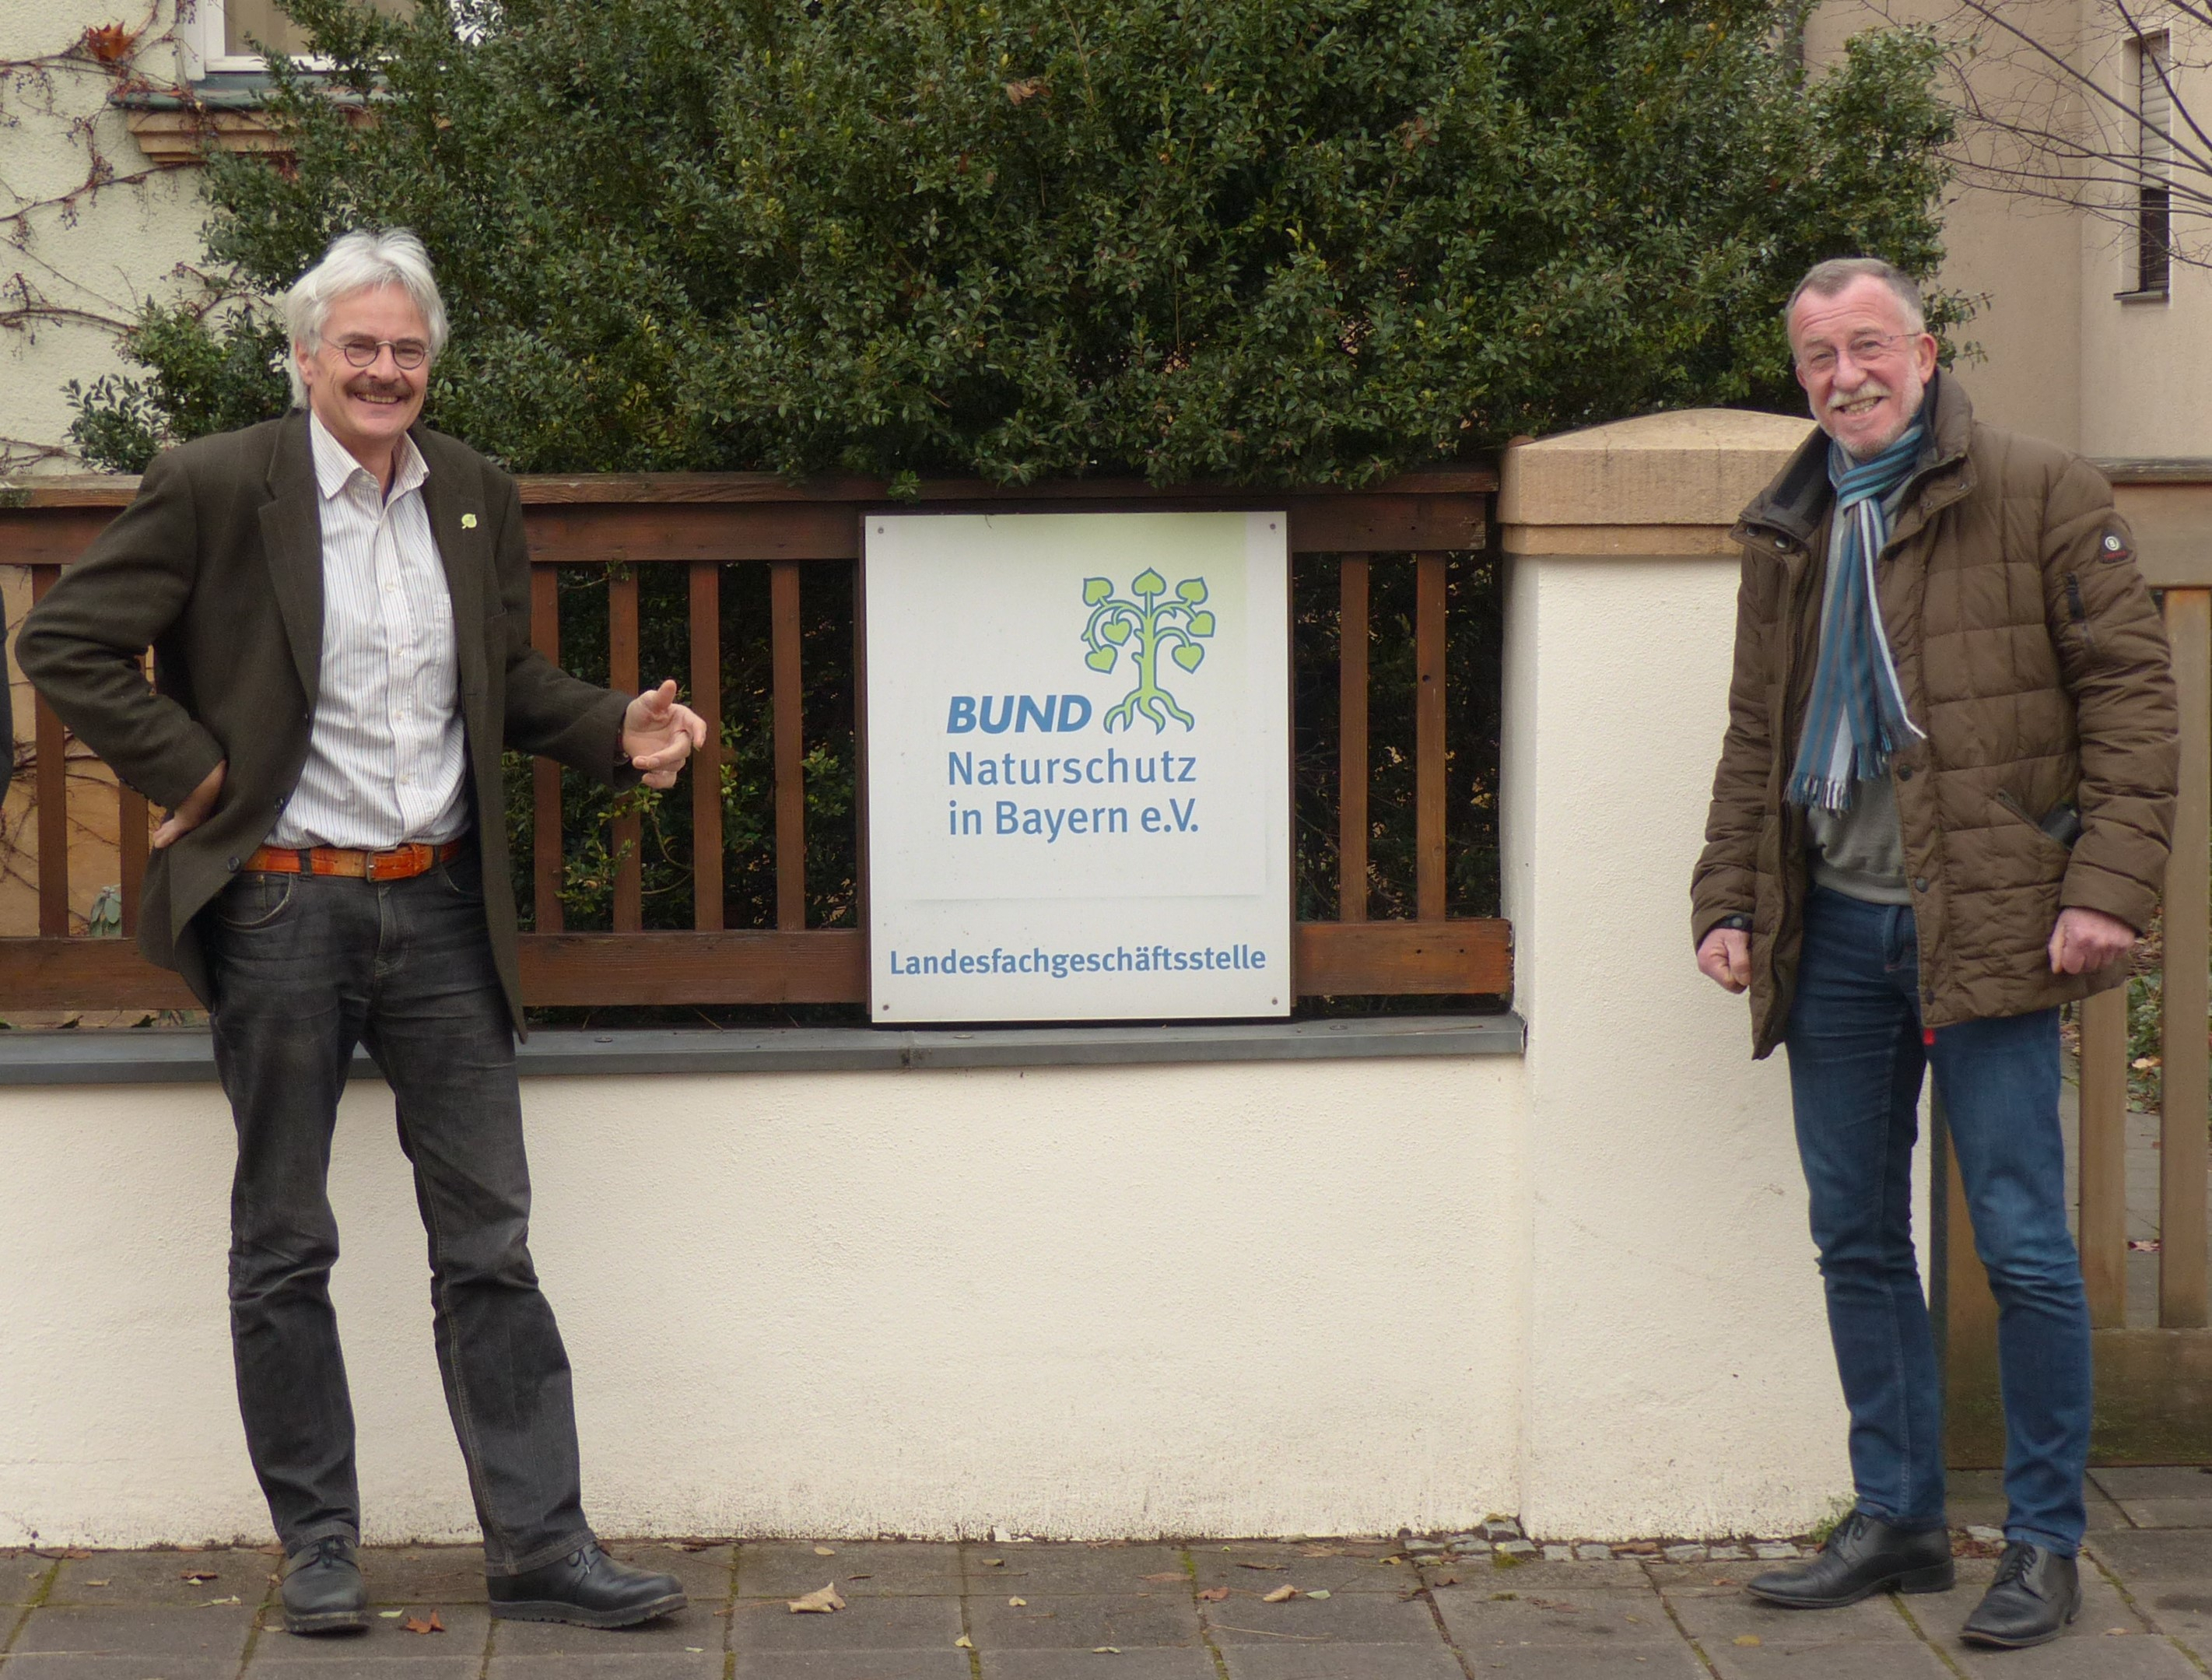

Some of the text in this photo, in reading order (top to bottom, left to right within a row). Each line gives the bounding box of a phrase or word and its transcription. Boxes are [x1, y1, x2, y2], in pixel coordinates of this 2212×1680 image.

[947, 695, 1092, 734] BUND
[948, 748, 1197, 785] Naturschutz
[949, 798, 1199, 843] in Bayern e.V.
[890, 944, 1266, 978] Landesfachgeschäftsstelle
